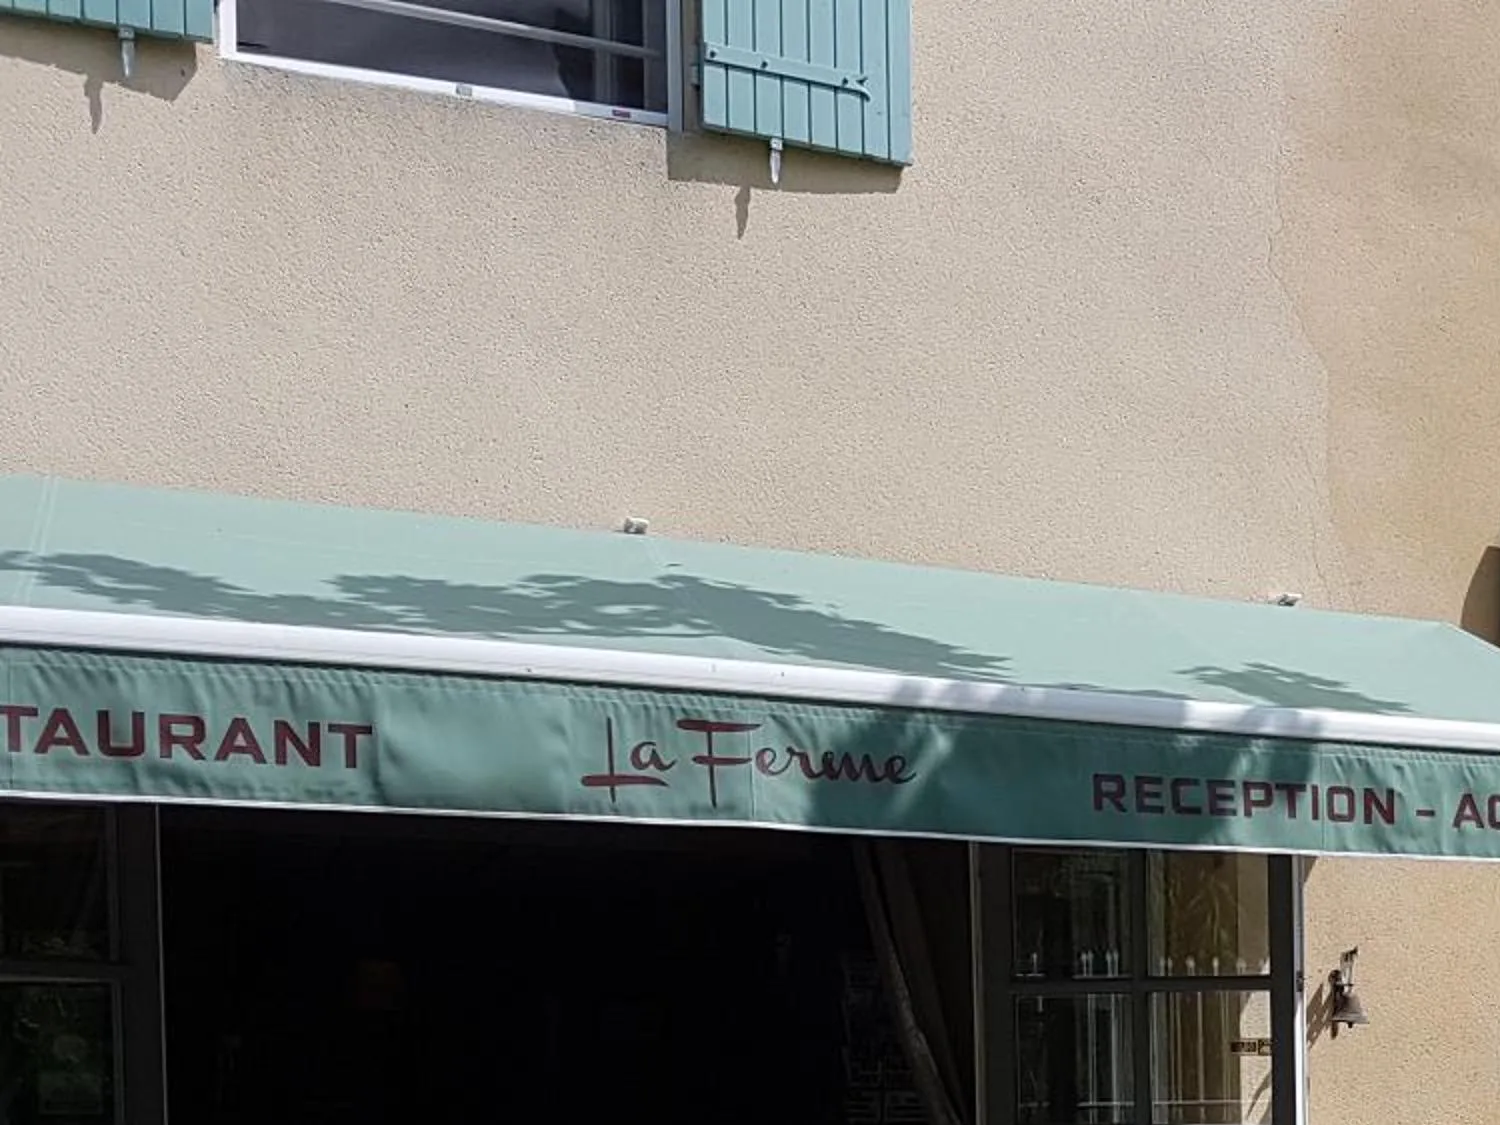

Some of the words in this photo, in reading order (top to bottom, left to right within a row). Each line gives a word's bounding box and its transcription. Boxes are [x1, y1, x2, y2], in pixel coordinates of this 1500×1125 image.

[581, 716, 677, 803] La
[676, 718, 917, 808] Ferme
[1093, 773, 1396, 825] RECEPTION
